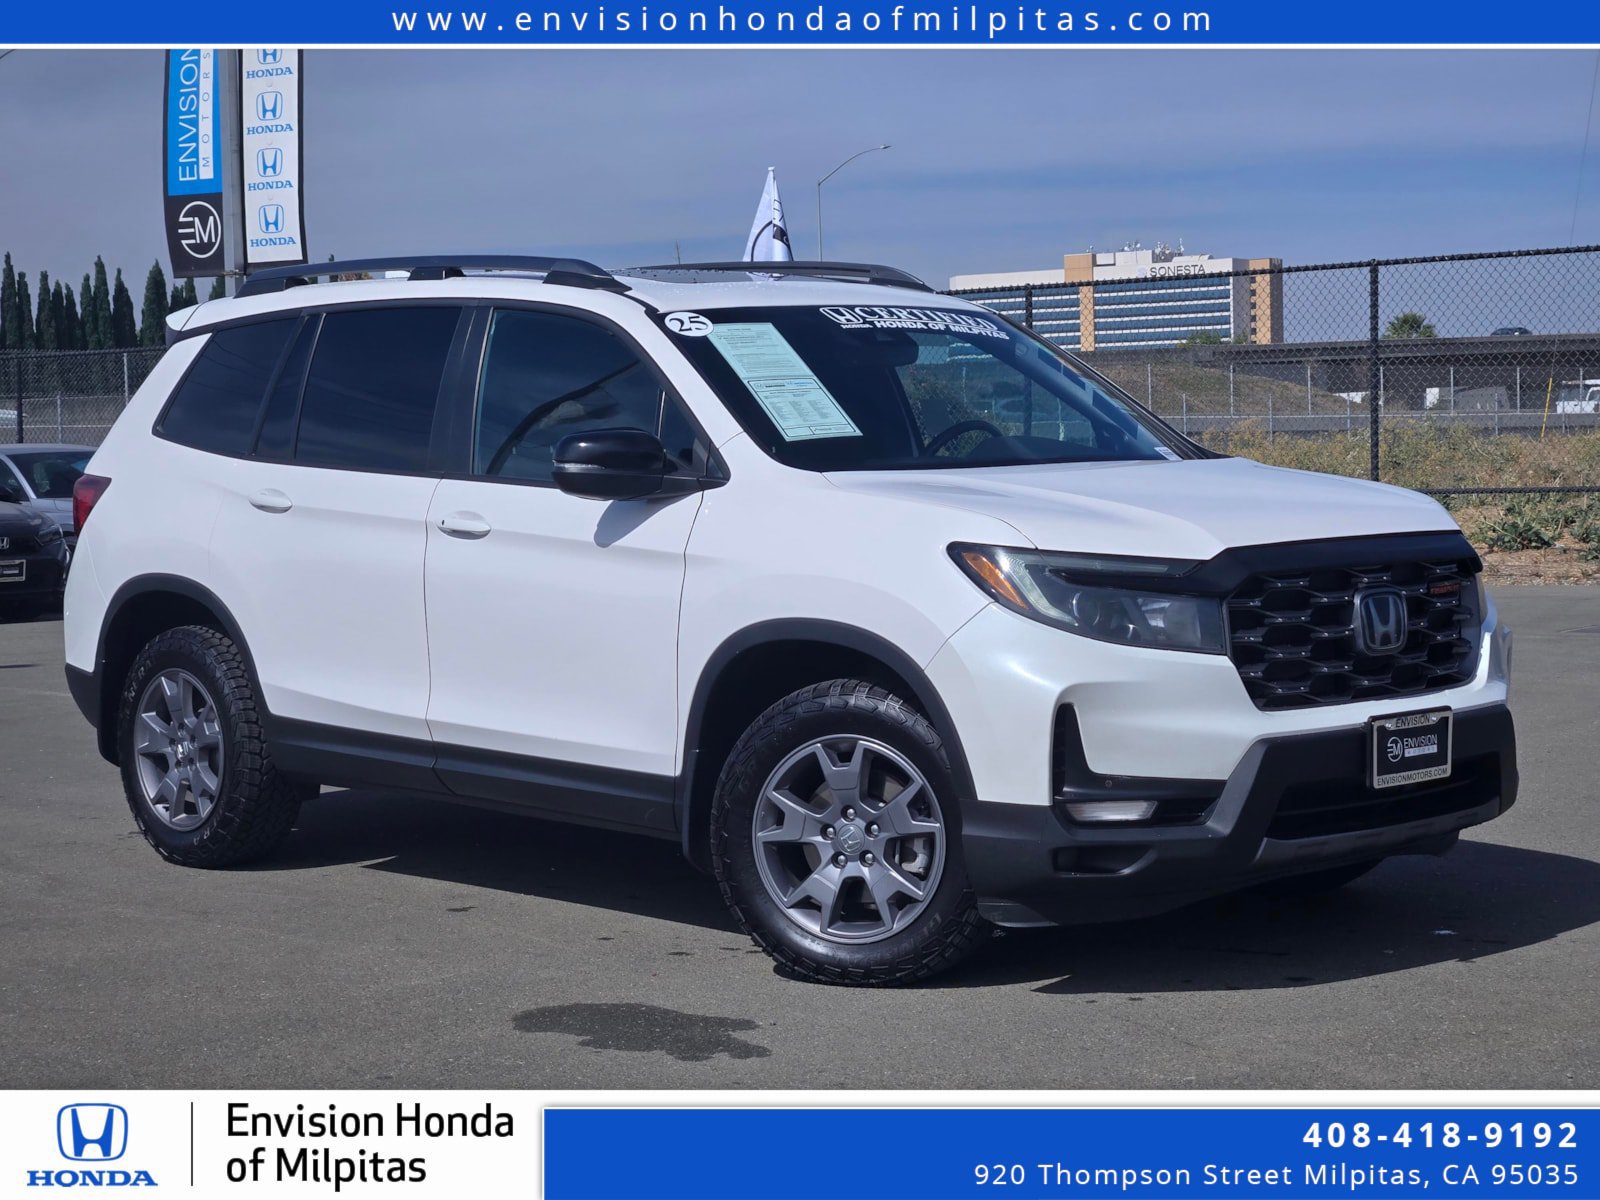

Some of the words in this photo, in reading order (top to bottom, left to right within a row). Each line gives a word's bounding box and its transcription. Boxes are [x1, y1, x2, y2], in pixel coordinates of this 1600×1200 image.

[246, 66, 293, 79] HONDA
[202, 51, 211, 168] MOTORS
[246, 123, 294, 135] HONDA
[247, 180, 294, 192] HONDA
[249, 236, 297, 248] HONDA
[1149, 264, 1206, 277] SONESTA
[668, 315, 709, 332] 25
[854, 306, 998, 331] CERTIFIED
[874, 320, 928, 330] HONDA
[928, 322, 946, 331] OF
[949, 325, 1010, 340] MILPITAS
[1395, 713, 1431, 728] ENVISION
[1403, 734, 1438, 749] ENVISION
[1377, 766, 1448, 786] ENVISIONMOTORS.COM
